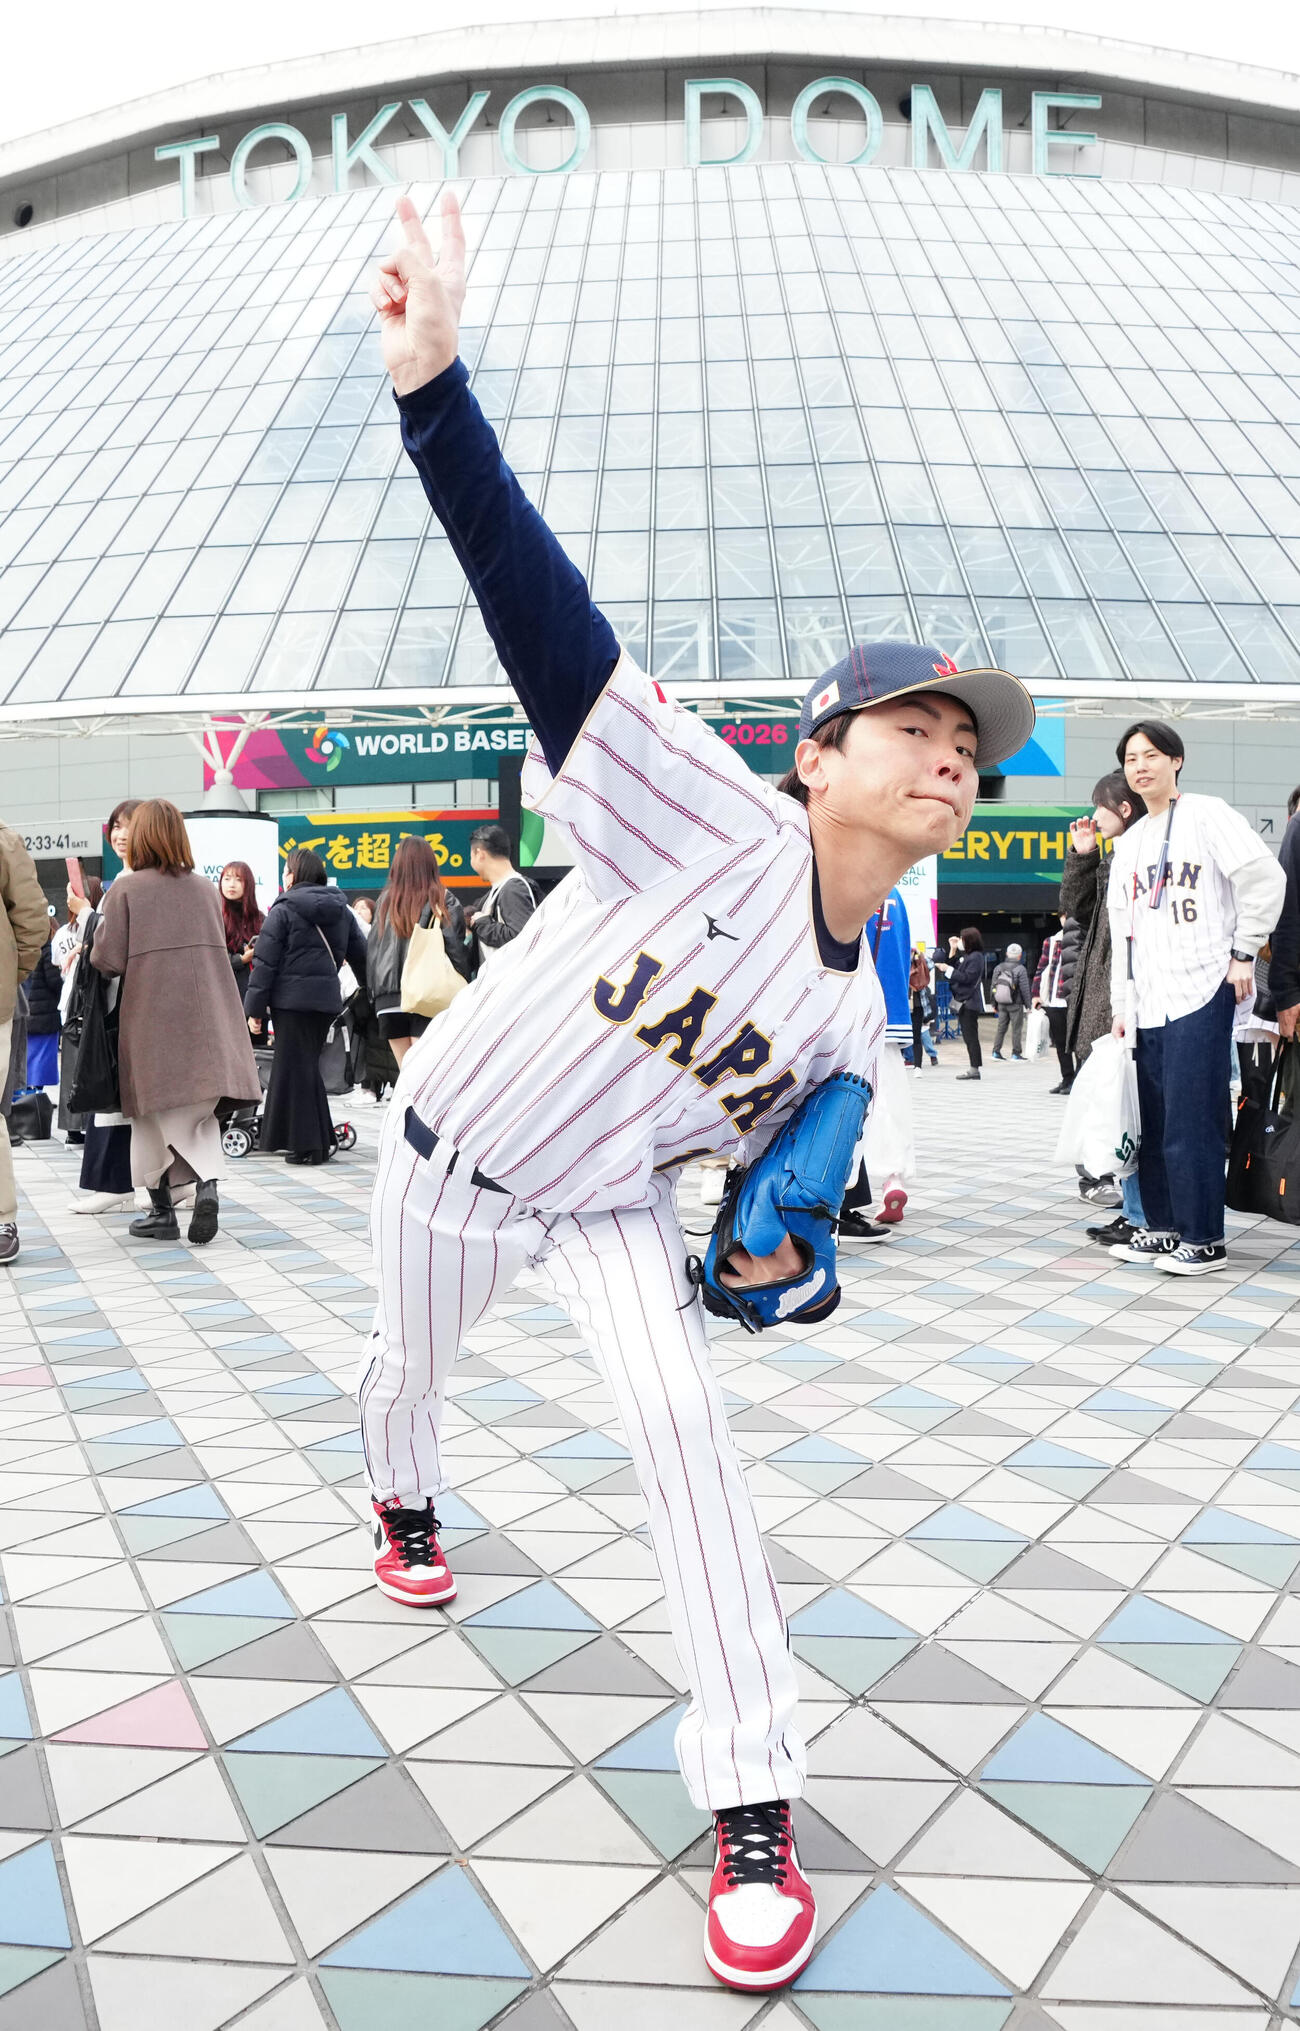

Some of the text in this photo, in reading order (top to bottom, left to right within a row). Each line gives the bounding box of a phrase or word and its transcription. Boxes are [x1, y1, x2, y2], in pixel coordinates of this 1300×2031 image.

[155, 75, 1102, 219] TOKYO DOME
[355, 732, 448, 757] WORLD
[722, 724, 788, 745] 2026
[1171, 898, 1198, 925] 16
